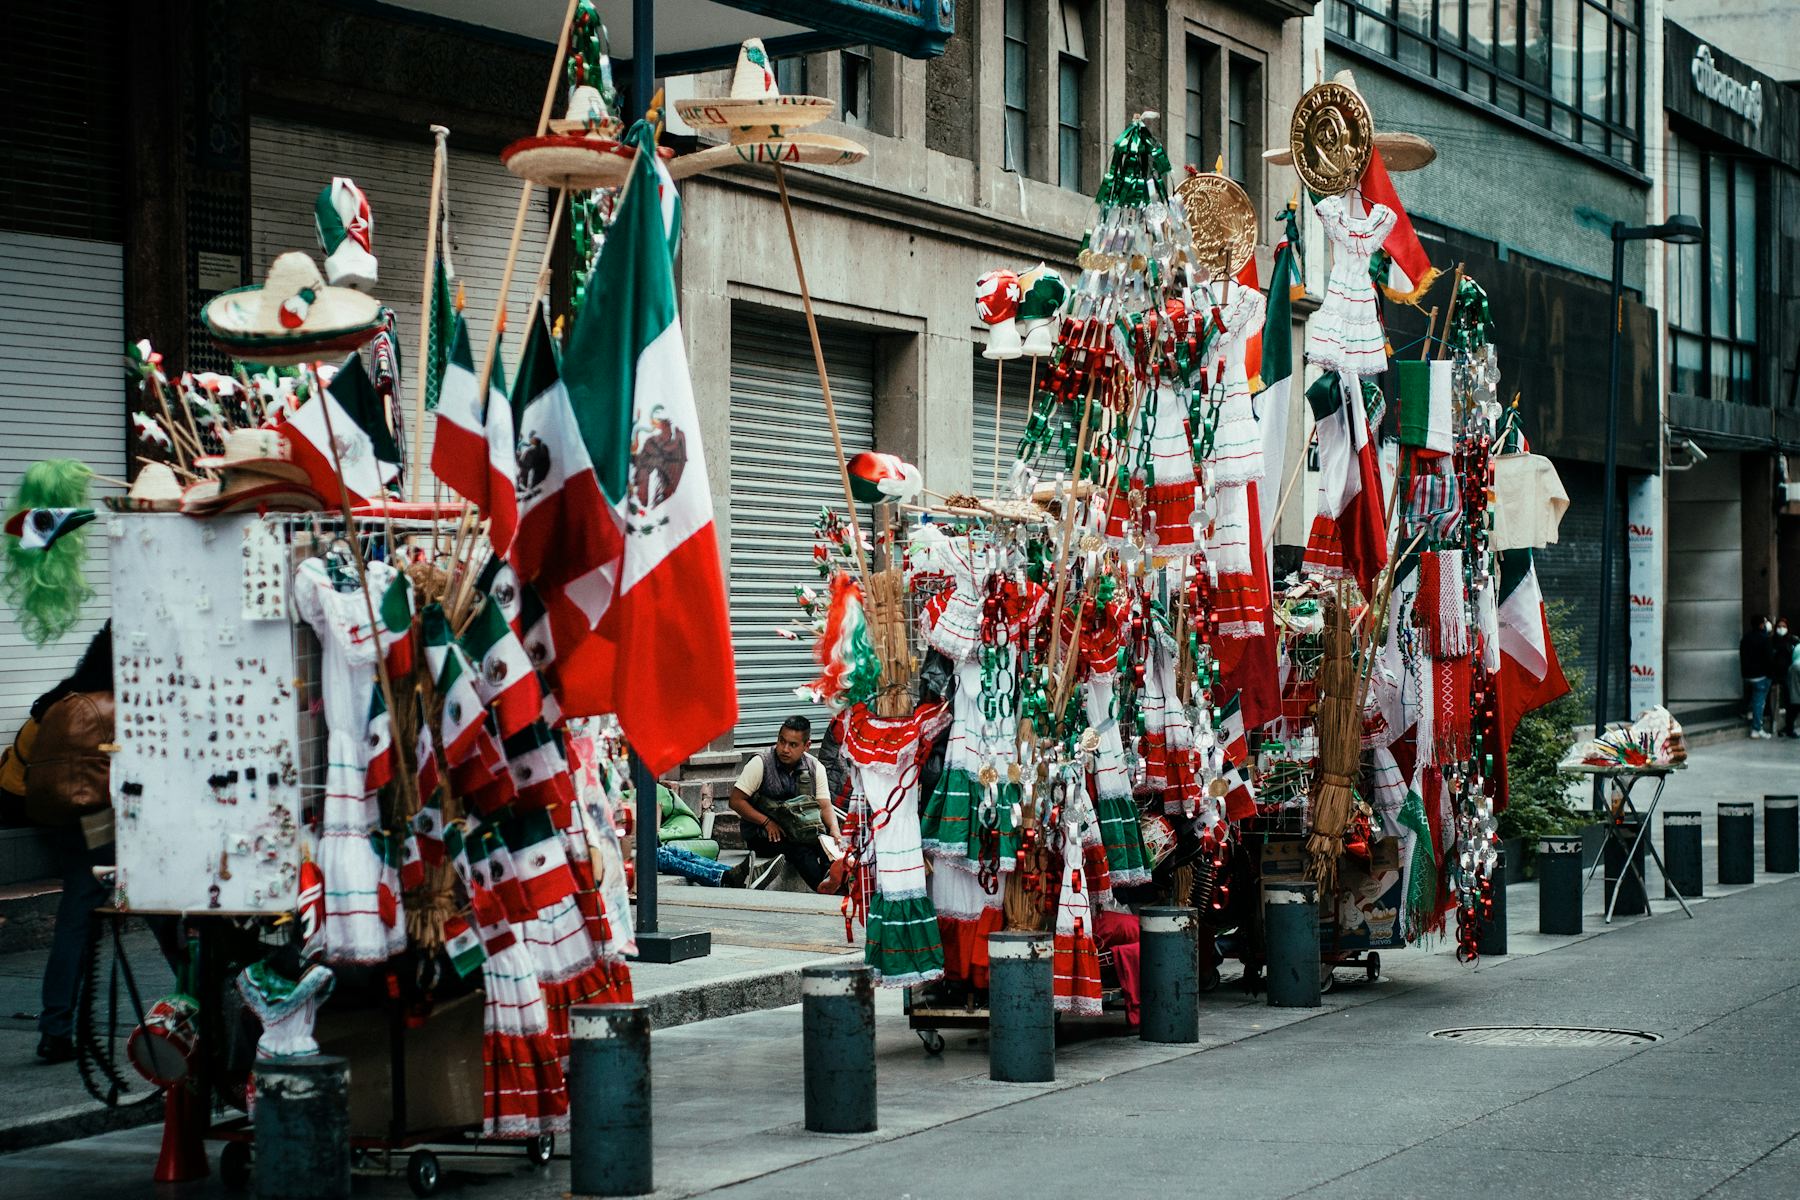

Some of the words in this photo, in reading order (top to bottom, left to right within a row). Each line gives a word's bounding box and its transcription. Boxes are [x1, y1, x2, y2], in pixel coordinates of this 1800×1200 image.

[1292, 108, 1313, 153] VIVA
[1311, 87, 1364, 120] MEXICO
[735, 143, 800, 163] VIVA
